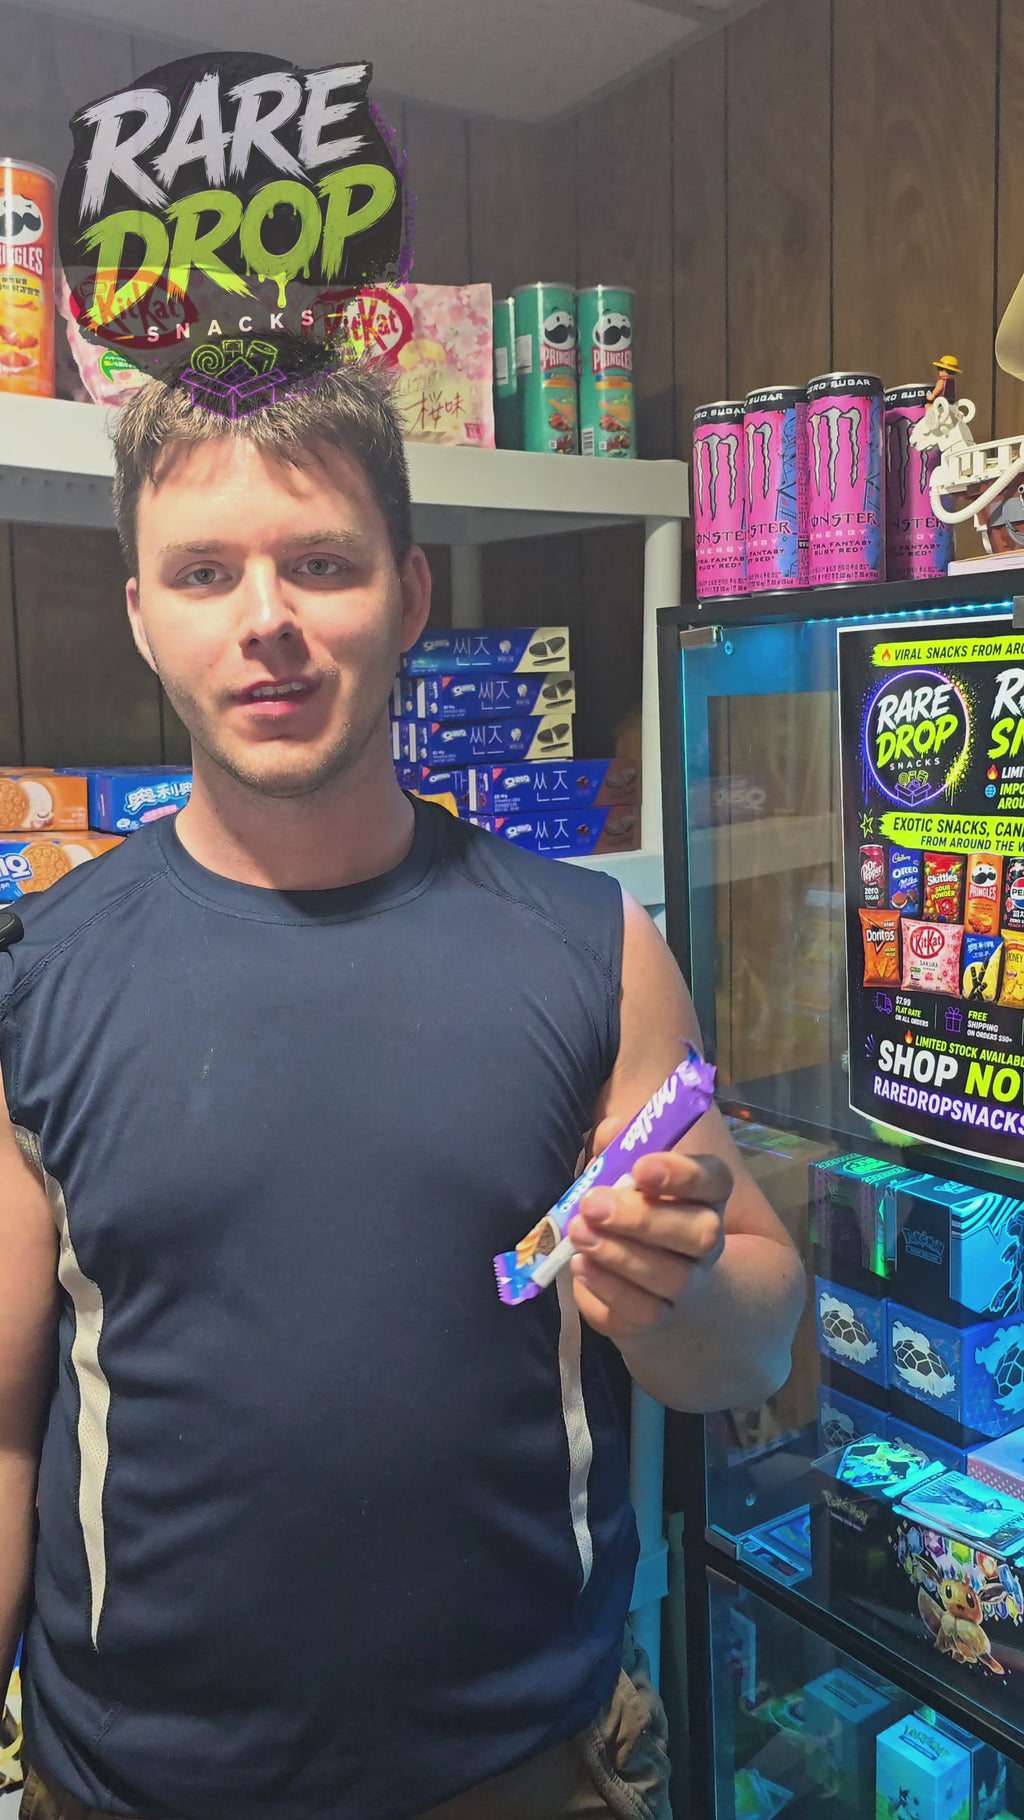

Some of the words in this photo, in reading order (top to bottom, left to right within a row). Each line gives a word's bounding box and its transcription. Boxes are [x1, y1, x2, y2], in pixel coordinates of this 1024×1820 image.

[830, 379, 871, 388] SUGAR
[895, 648, 922, 661] VIRAL
[926, 645, 968, 659] SNACKS
[971, 643, 1003, 657] FROM
[991, 667, 1024, 720] R
[877, 683, 954, 735] RARE
[876, 714, 958, 769] DROP
[889, 757, 940, 771] SNACKS
[1001, 766, 1024, 780] LIMI
[893, 817, 933, 833] EXOTIC
[936, 819, 990, 838] SNACKS,
[995, 821, 1024, 838] CAN
[920, 836, 947, 847] FROM
[949, 837, 991, 850] AROUND
[995, 840, 1015, 852] THE
[892, 866, 918, 879] OREO
[927, 872, 958, 886] Skittles
[864, 887, 879, 895] zero
[935, 884, 951, 892] SOUR
[969, 884, 997, 901] PRINGLES
[1012, 888, 1024, 897] PE
[931, 890, 956, 901] POWDER
[866, 929, 895, 942] Doritos
[915, 930, 941, 955] KitKat
[895, 995, 911, 1007] $7.99
[895, 1006, 907, 1015] FLAT
[907, 1007, 922, 1017] RATE
[968, 1010, 988, 1022] FREE
[911, 1017, 929, 1027] ORDERS
[967, 1020, 998, 1032] SHIPPING
[967, 1029, 975, 1037] ON
[975, 1031, 998, 1041] ORDERS
[915, 1035, 948, 1052] LIMITED
[948, 1041, 979, 1058] STOCK
[878, 1039, 959, 1087] SHOP
[965, 1061, 1024, 1103] NO
[620, 1074, 678, 1151] Milka
